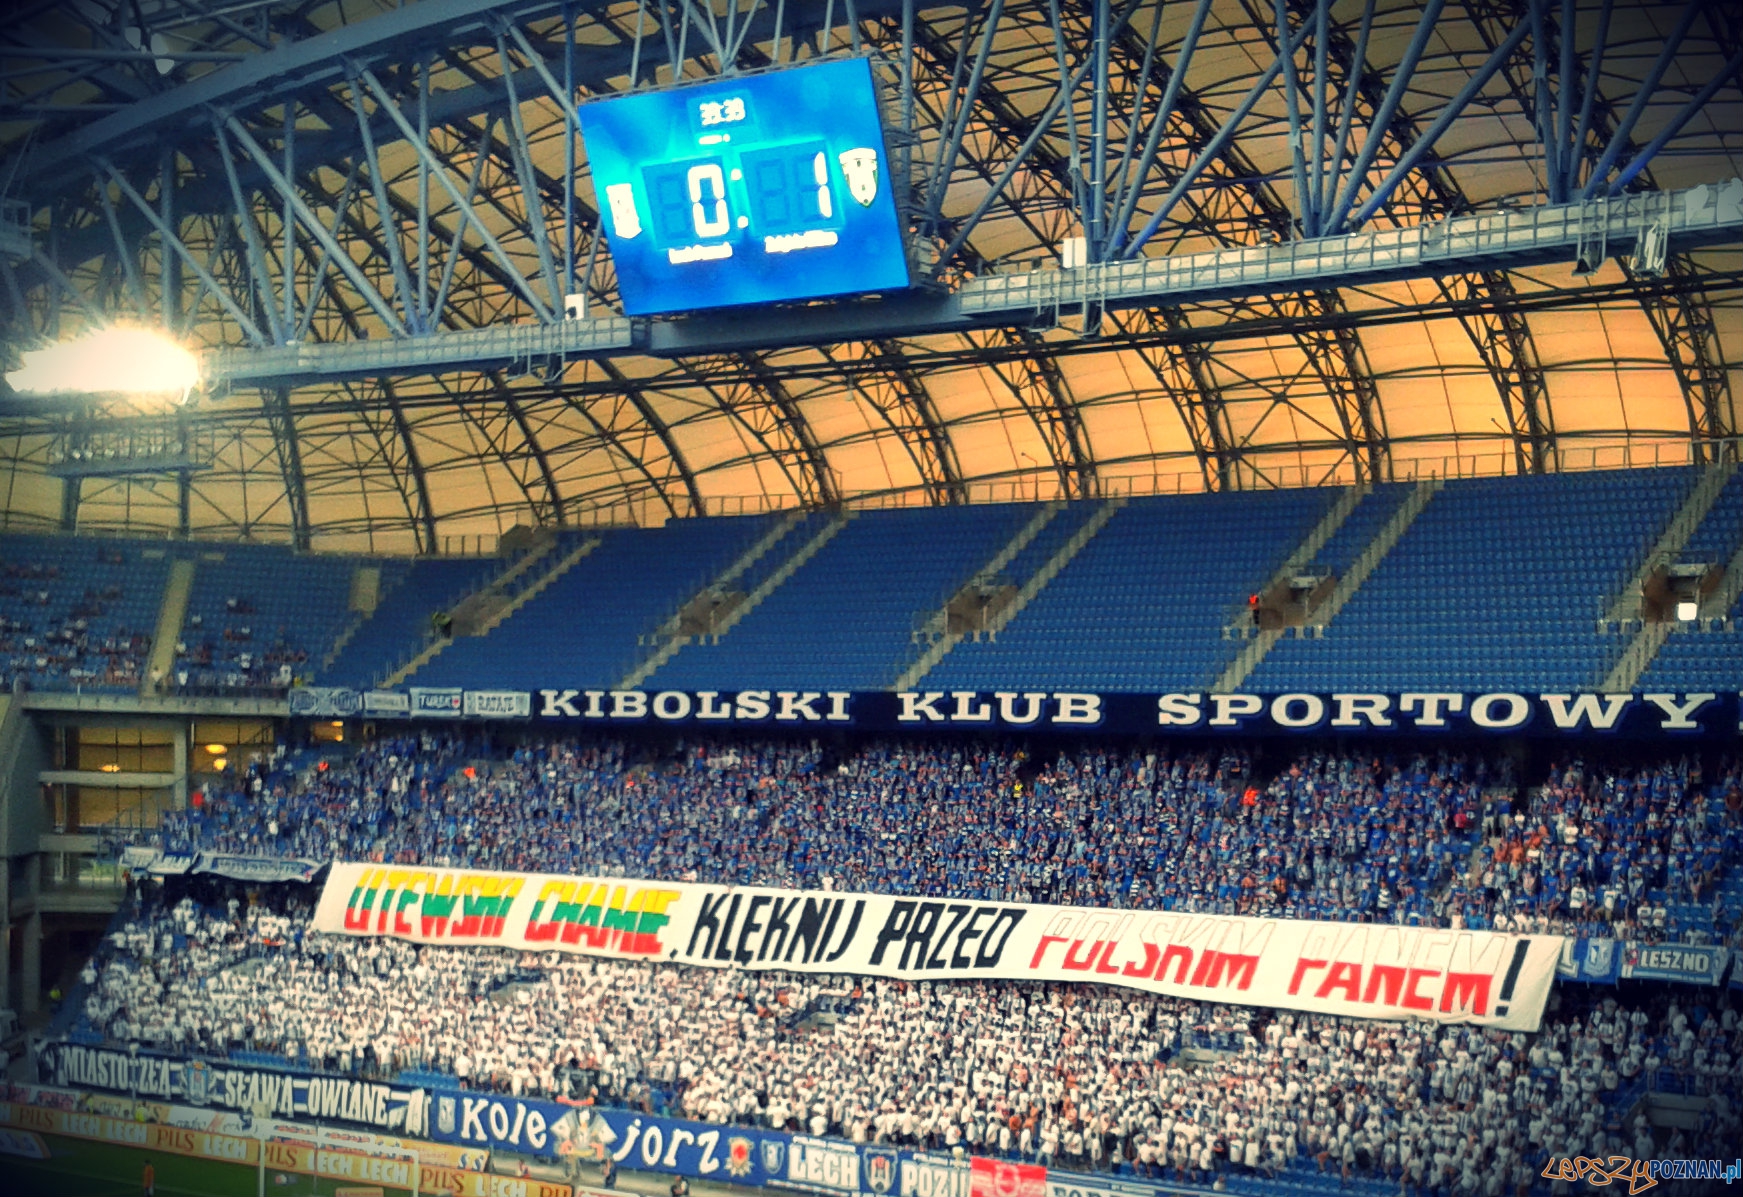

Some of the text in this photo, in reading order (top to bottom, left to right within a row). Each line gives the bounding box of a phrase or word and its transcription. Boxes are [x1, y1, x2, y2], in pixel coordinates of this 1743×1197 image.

[540, 689, 851, 721] KIBOLSKI
[897, 691, 1102, 723] KLUB
[1158, 693, 1716, 729] SPORTOWY
[868, 900, 1027, 970] PRZED
[1029, 910, 1277, 991] POLSKIM
[1640, 950, 1709, 973] LESZNO
[63, 1044, 128, 1091] MIASTO
[156, 1127, 196, 1151] PILS
[203, 1134, 247, 1160] LECH
[360, 1156, 410, 1186] LECH
[420, 1167, 465, 1194] PILS
[788, 1145, 862, 1191] LECH
